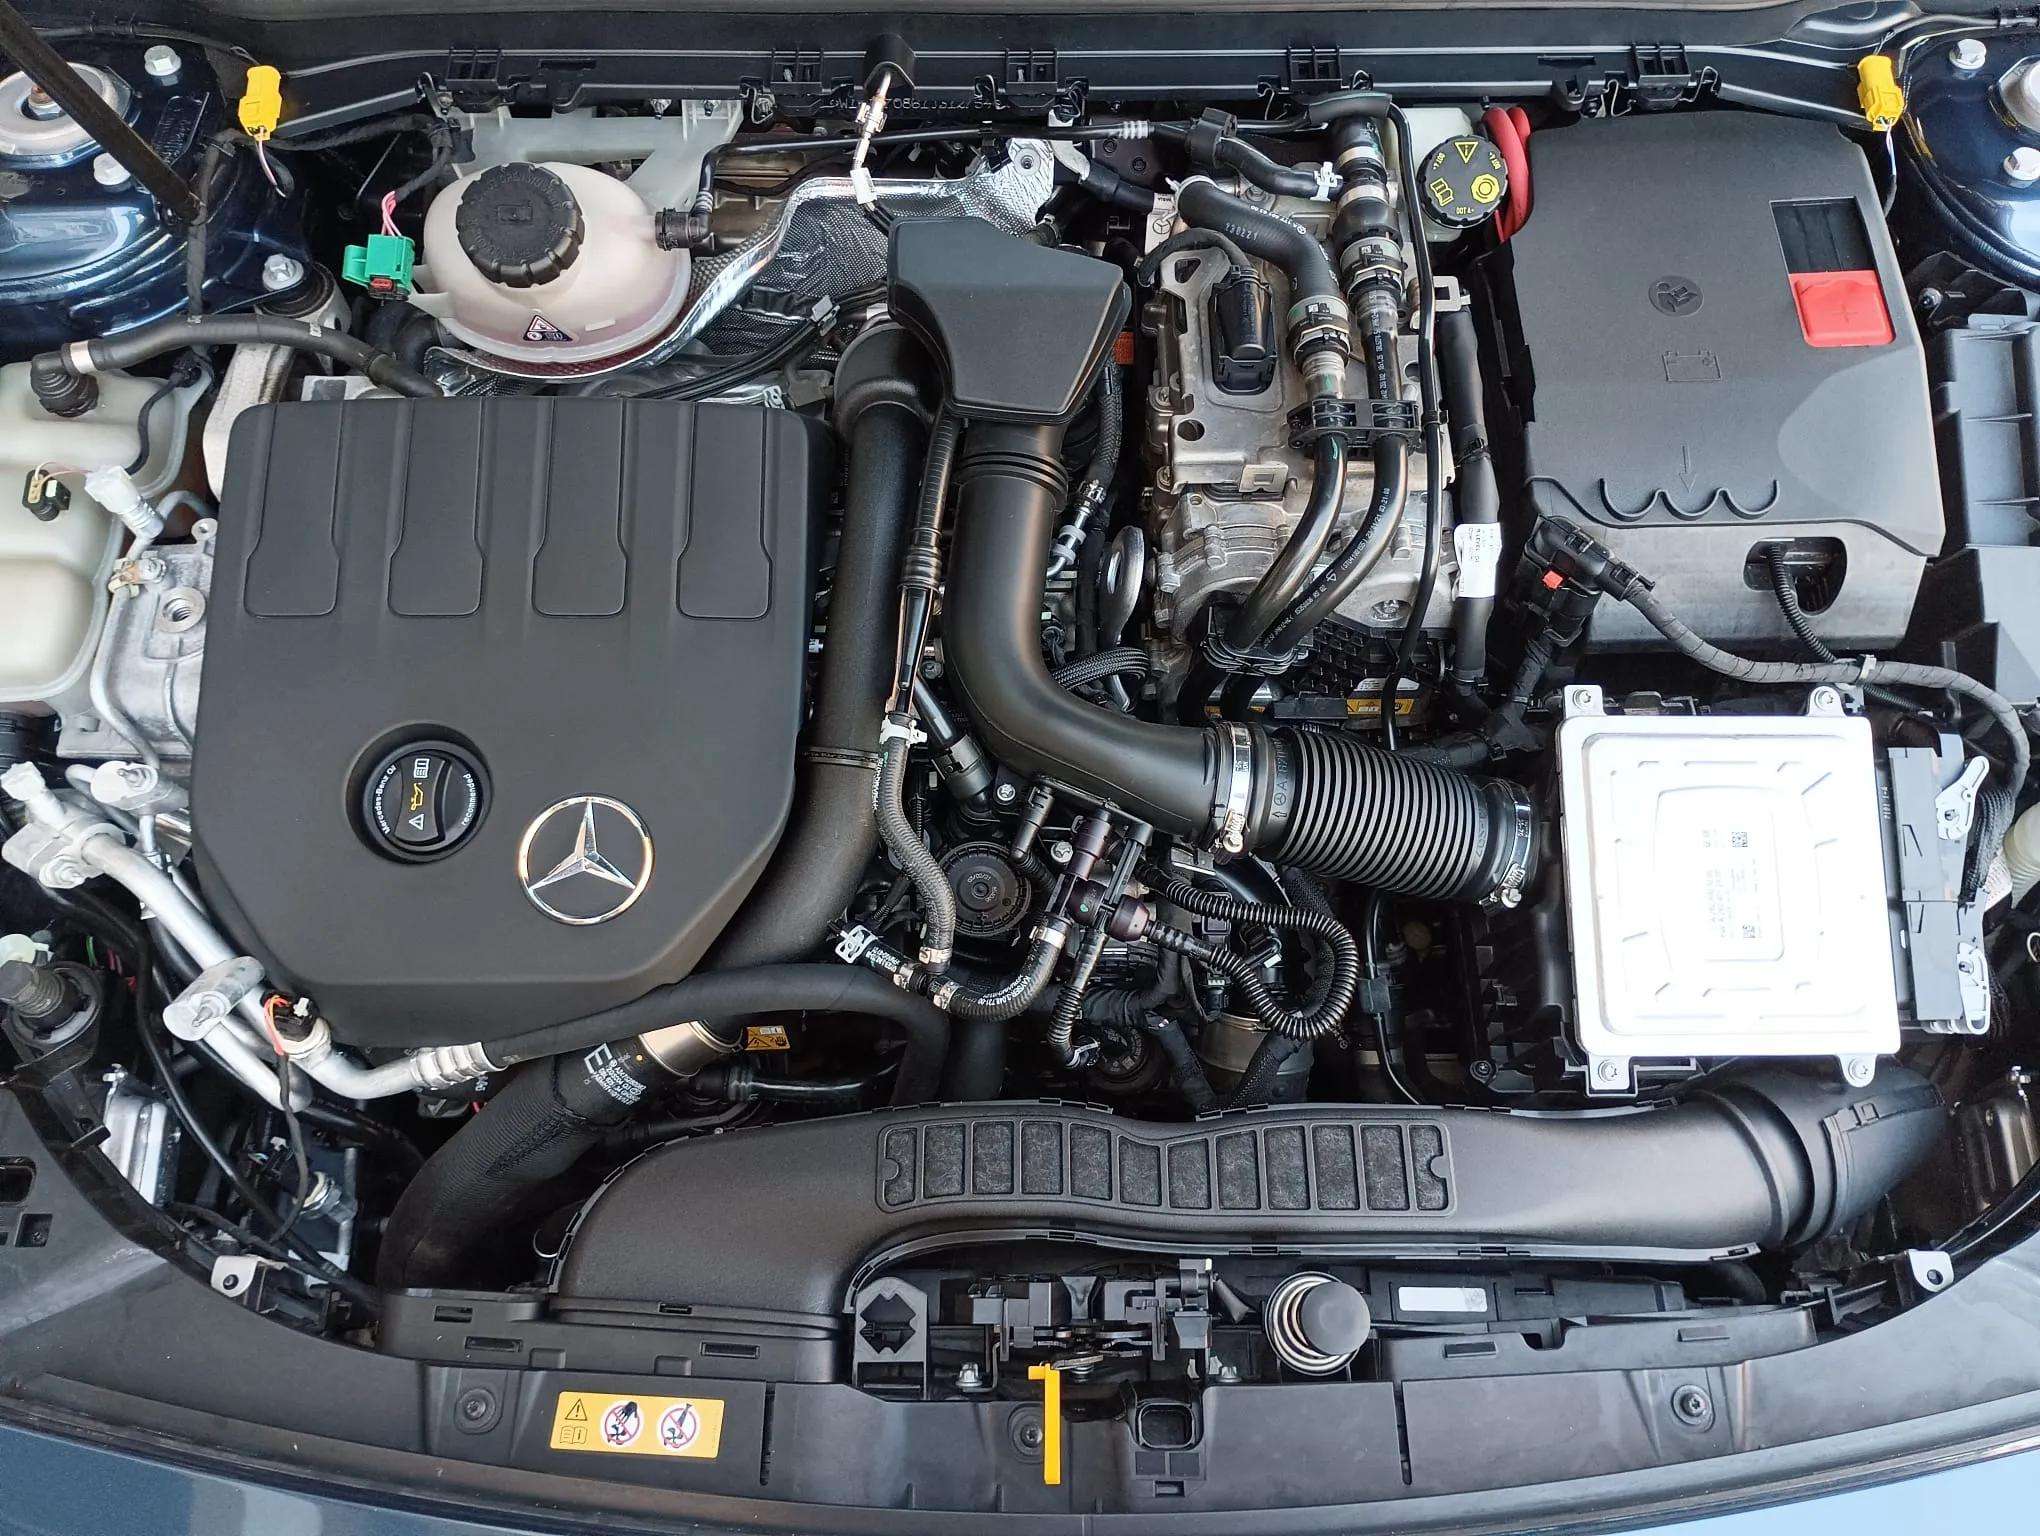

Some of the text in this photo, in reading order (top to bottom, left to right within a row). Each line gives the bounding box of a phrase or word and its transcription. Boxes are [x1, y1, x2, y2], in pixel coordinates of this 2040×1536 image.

[375, 764, 397, 835] Mercedes-Benz Oil
[461, 773, 477, 826] recommended
